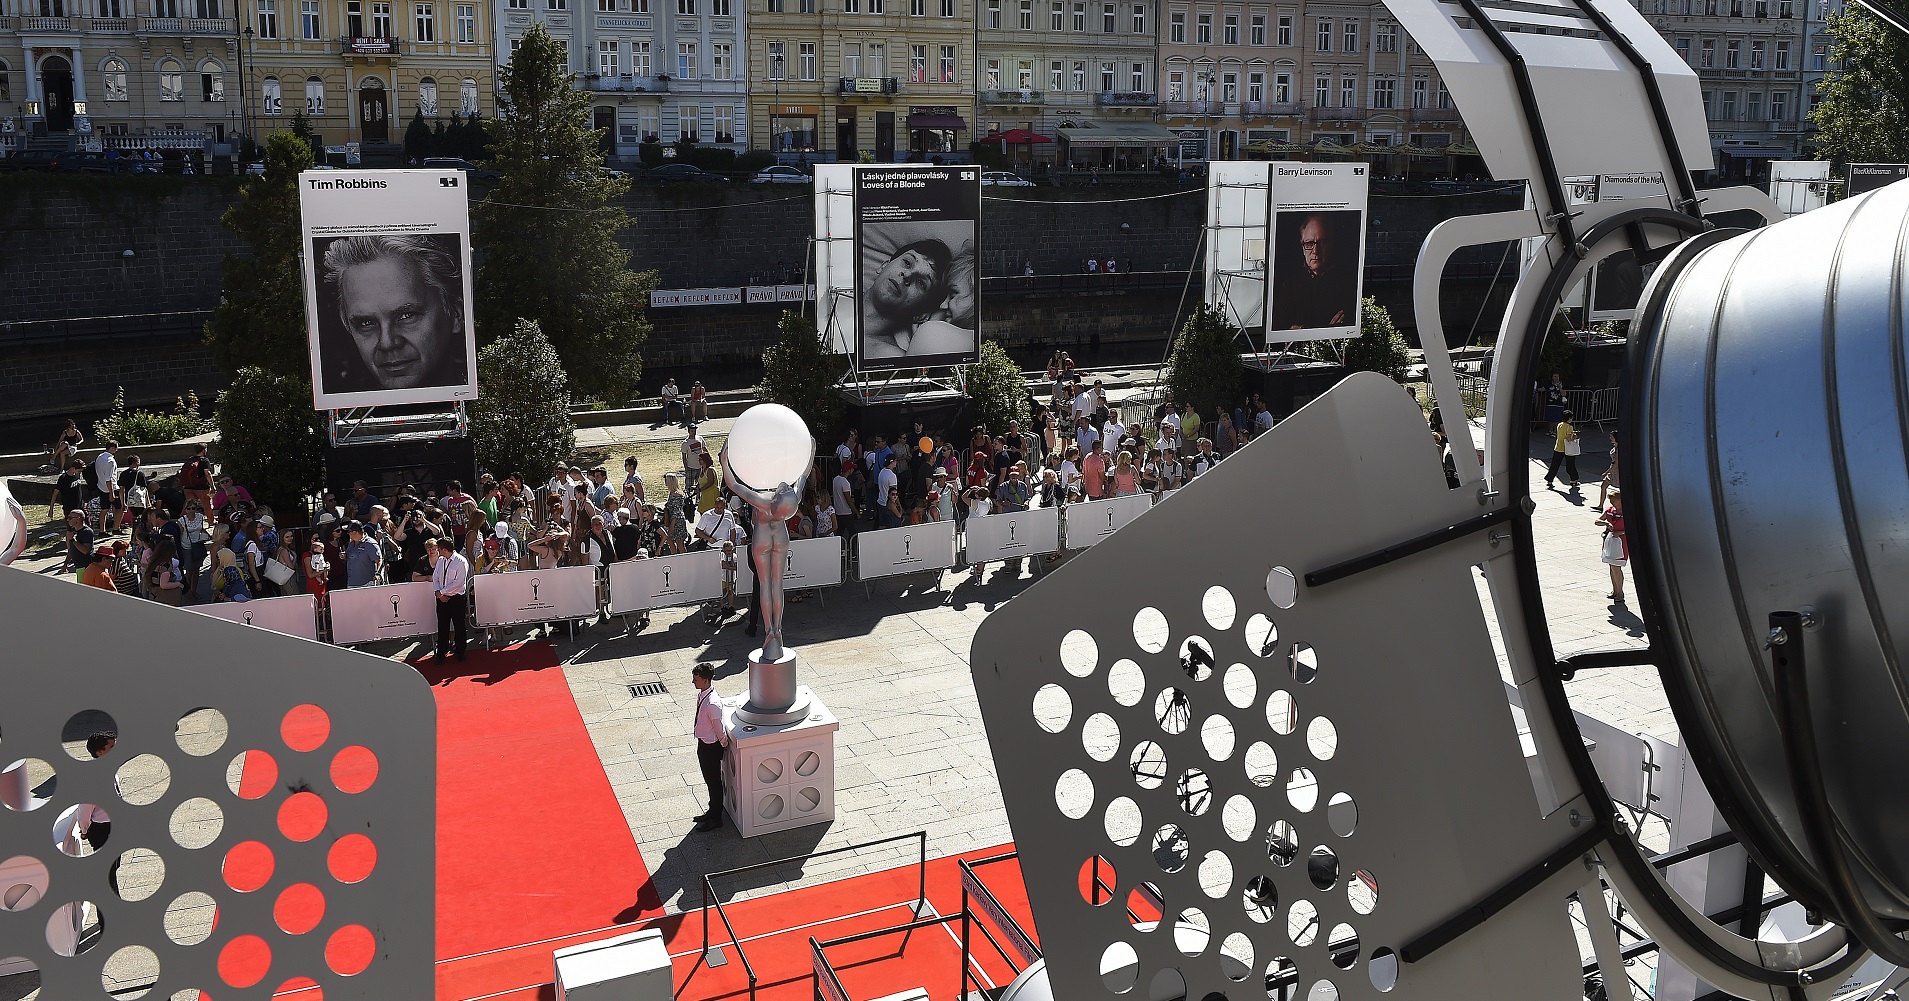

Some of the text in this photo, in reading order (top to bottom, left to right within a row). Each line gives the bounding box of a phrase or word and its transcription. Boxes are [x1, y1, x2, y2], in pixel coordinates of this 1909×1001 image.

[862, 171, 949, 181] Lásky jedné plavovlásky
[1278, 168, 1299, 177] Barry
[309, 178, 387, 189] Tim Robbins
[1605, 175, 1633, 183] Diamonds
[1651, 176, 1664, 184] Nigh
[683, 294, 709, 303] REFLEX
[714, 293, 739, 301] REFLEX
[750, 290, 772, 301] PRÁVO
